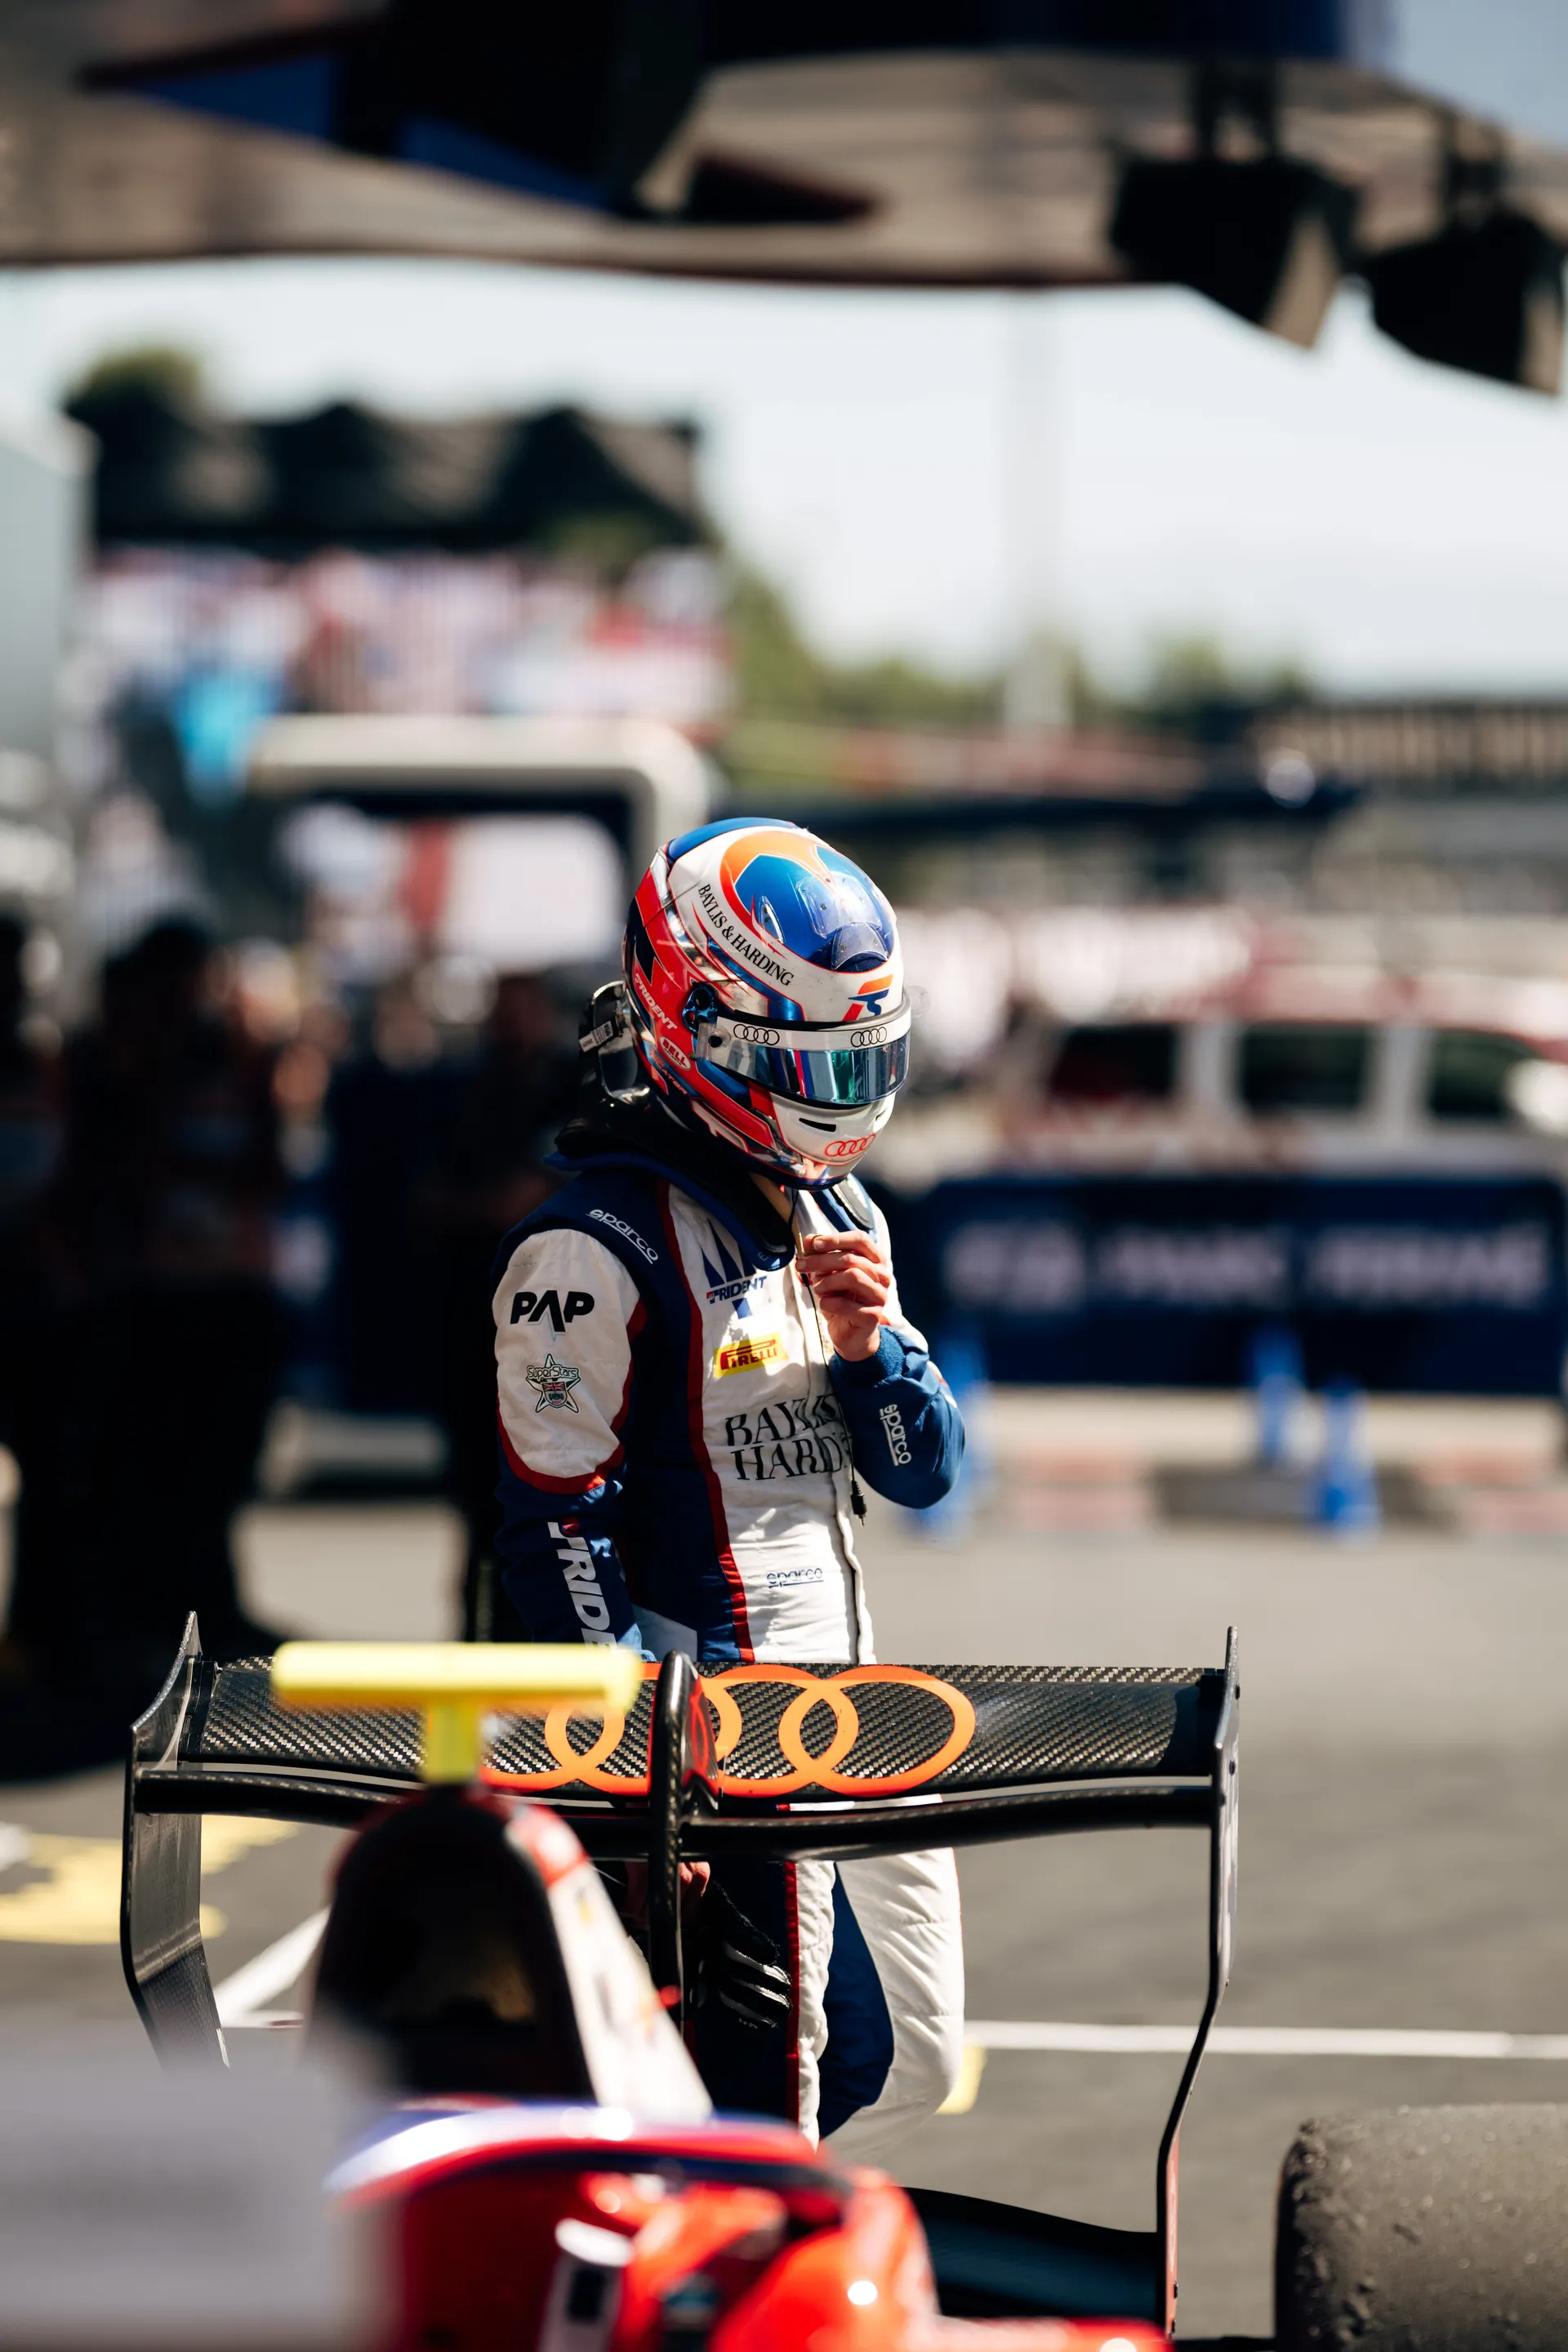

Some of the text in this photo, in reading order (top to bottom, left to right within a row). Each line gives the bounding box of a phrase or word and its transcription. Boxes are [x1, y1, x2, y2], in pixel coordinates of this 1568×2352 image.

[698, 884, 795, 987] BAYLIS & HARDING
[635, 973, 678, 1030] TRIDENT
[662, 1039, 688, 1067] BELL
[586, 1209, 659, 1264] sparco
[510, 1290, 595, 1333] PAP
[706, 1276, 768, 1305] TRIDENT
[719, 1339, 777, 1370] PIRELLI
[879, 1404, 912, 1467] sparco
[766, 1567, 824, 1589] sparco
